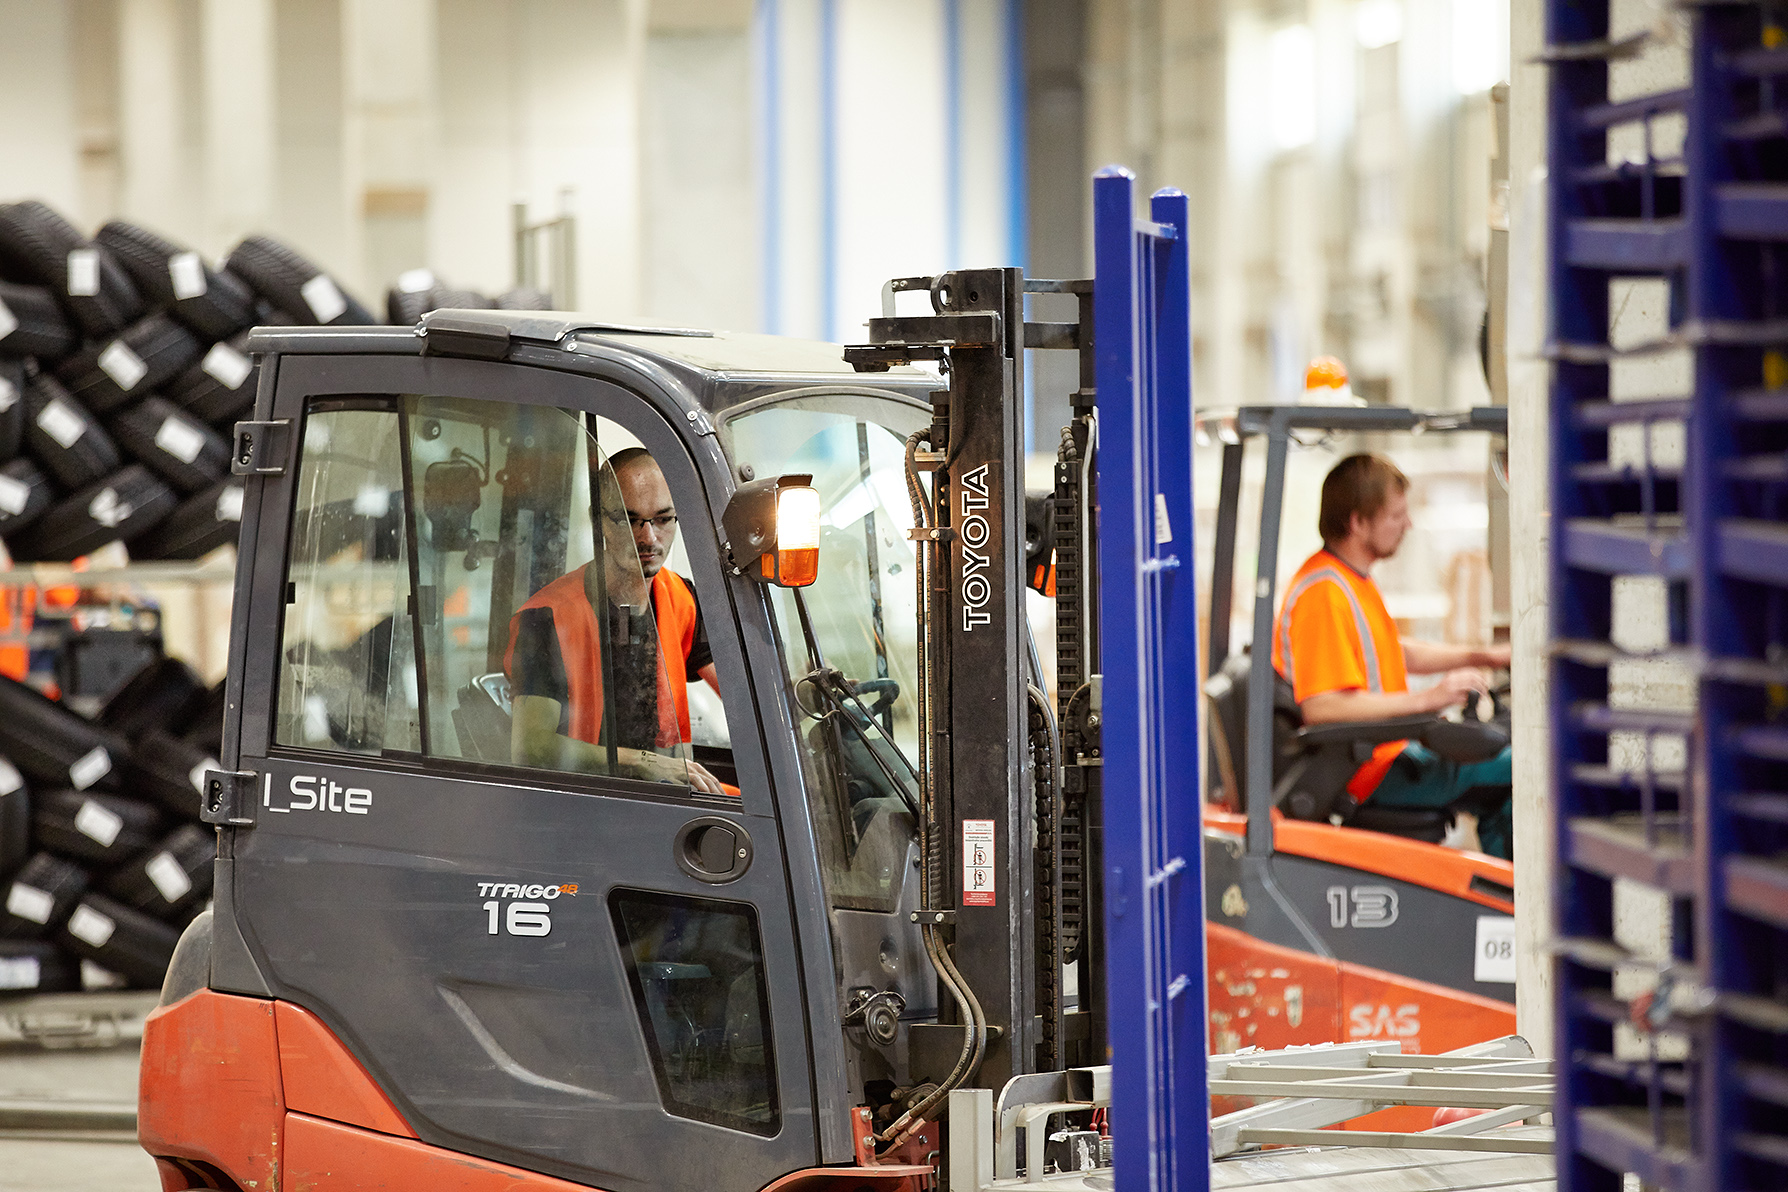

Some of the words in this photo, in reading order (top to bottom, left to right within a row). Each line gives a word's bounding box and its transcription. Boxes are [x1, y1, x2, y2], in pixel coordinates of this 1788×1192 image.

[961, 463, 991, 632] TOYOTA
[263, 772, 373, 815] I_Site
[483, 901, 551, 937] 16
[1327, 885, 1399, 929] 13
[1484, 940, 1512, 960] 08
[1350, 1003, 1421, 1038] SAS
